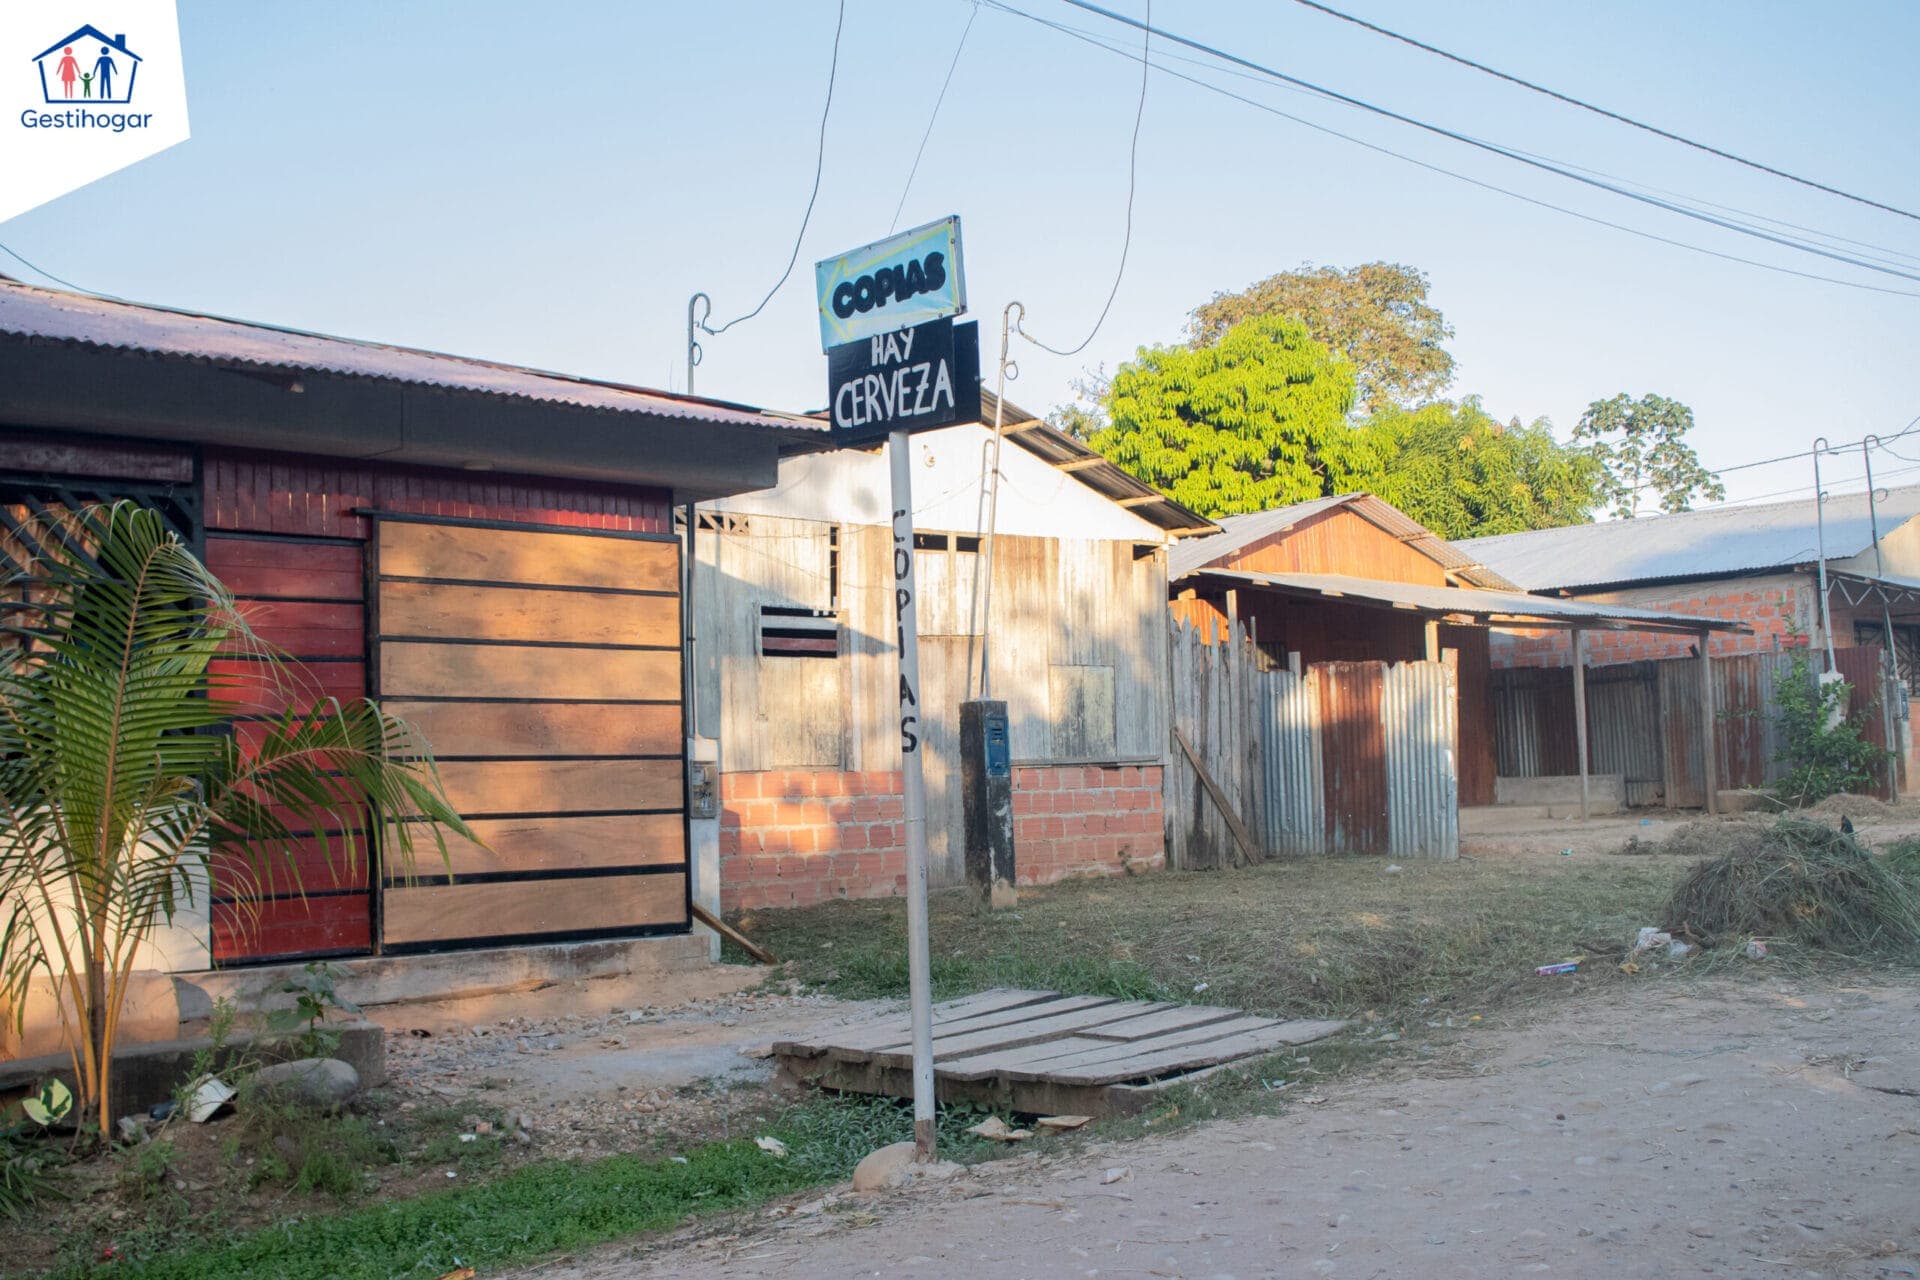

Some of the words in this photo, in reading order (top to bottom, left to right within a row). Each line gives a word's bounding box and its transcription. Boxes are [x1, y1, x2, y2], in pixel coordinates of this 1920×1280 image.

[832, 251, 946, 319] COPIAS
[871, 328, 914, 367] HAY
[835, 358, 955, 428] CERVEZA
[892, 509, 918, 753] COPIAS
